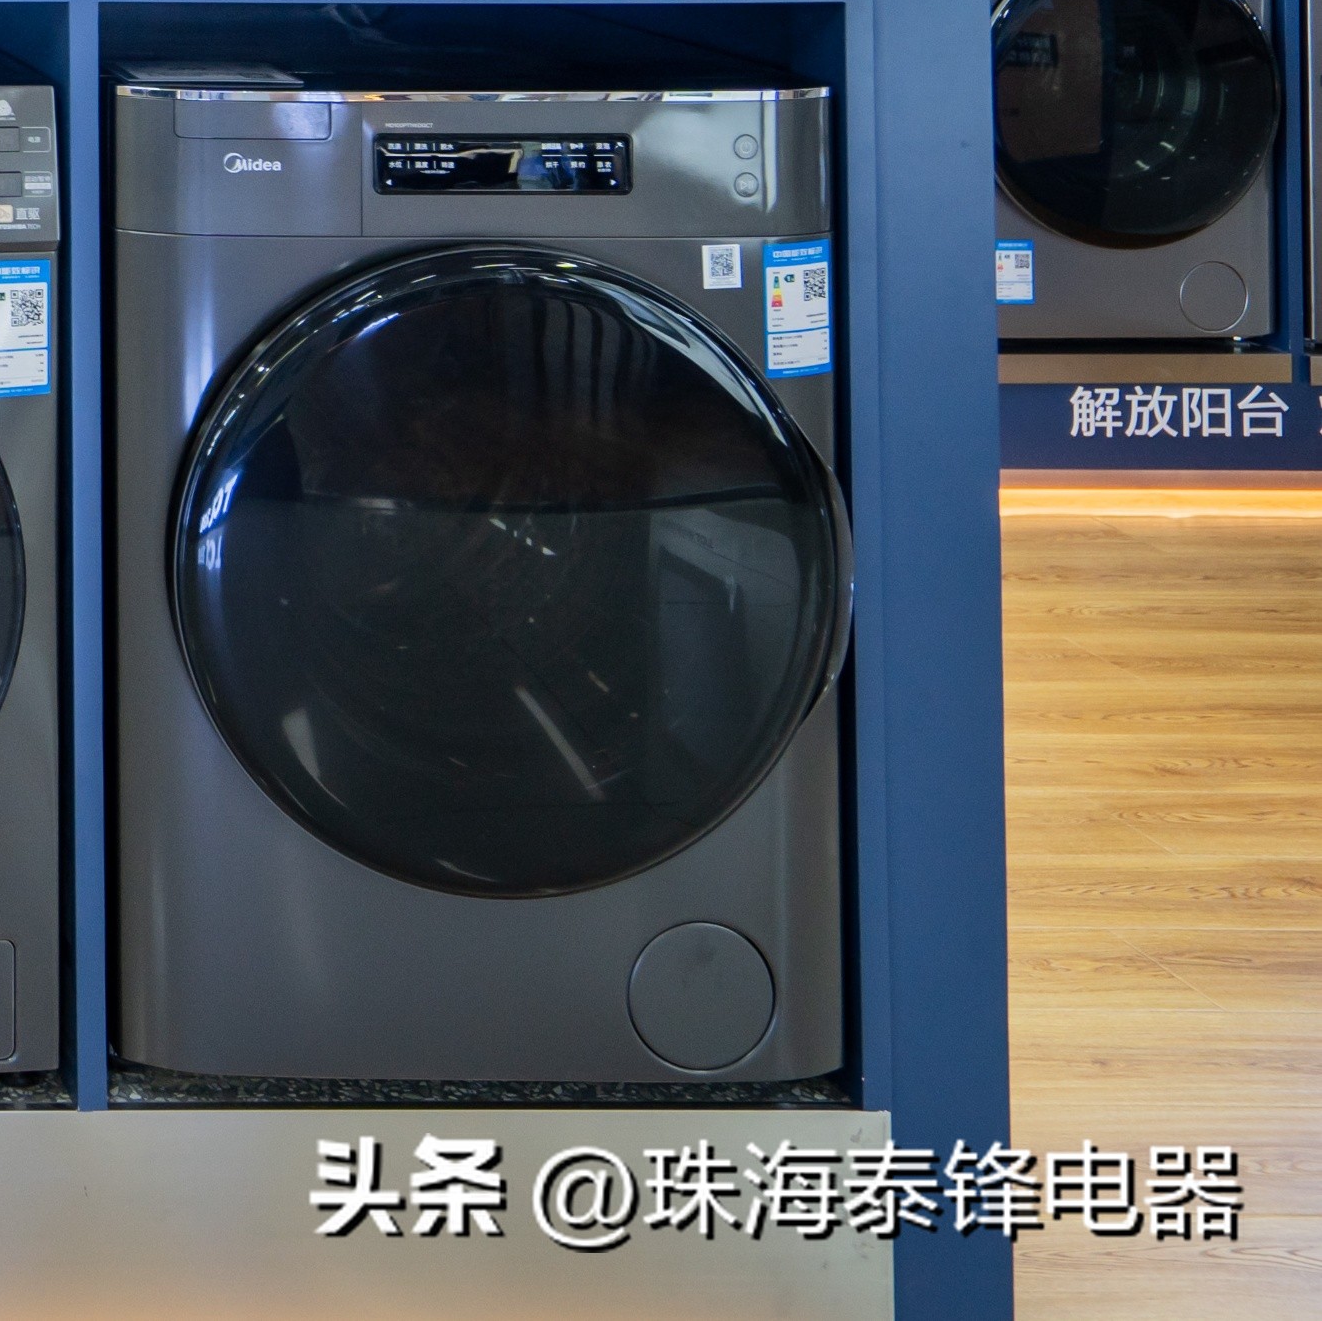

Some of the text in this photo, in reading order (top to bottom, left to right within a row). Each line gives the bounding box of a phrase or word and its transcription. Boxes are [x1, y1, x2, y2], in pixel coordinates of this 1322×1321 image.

[224, 151, 282, 173] Midea
[16, 207, 41, 220] 直驱
[1069, 384, 1290, 438] 解放阳台
